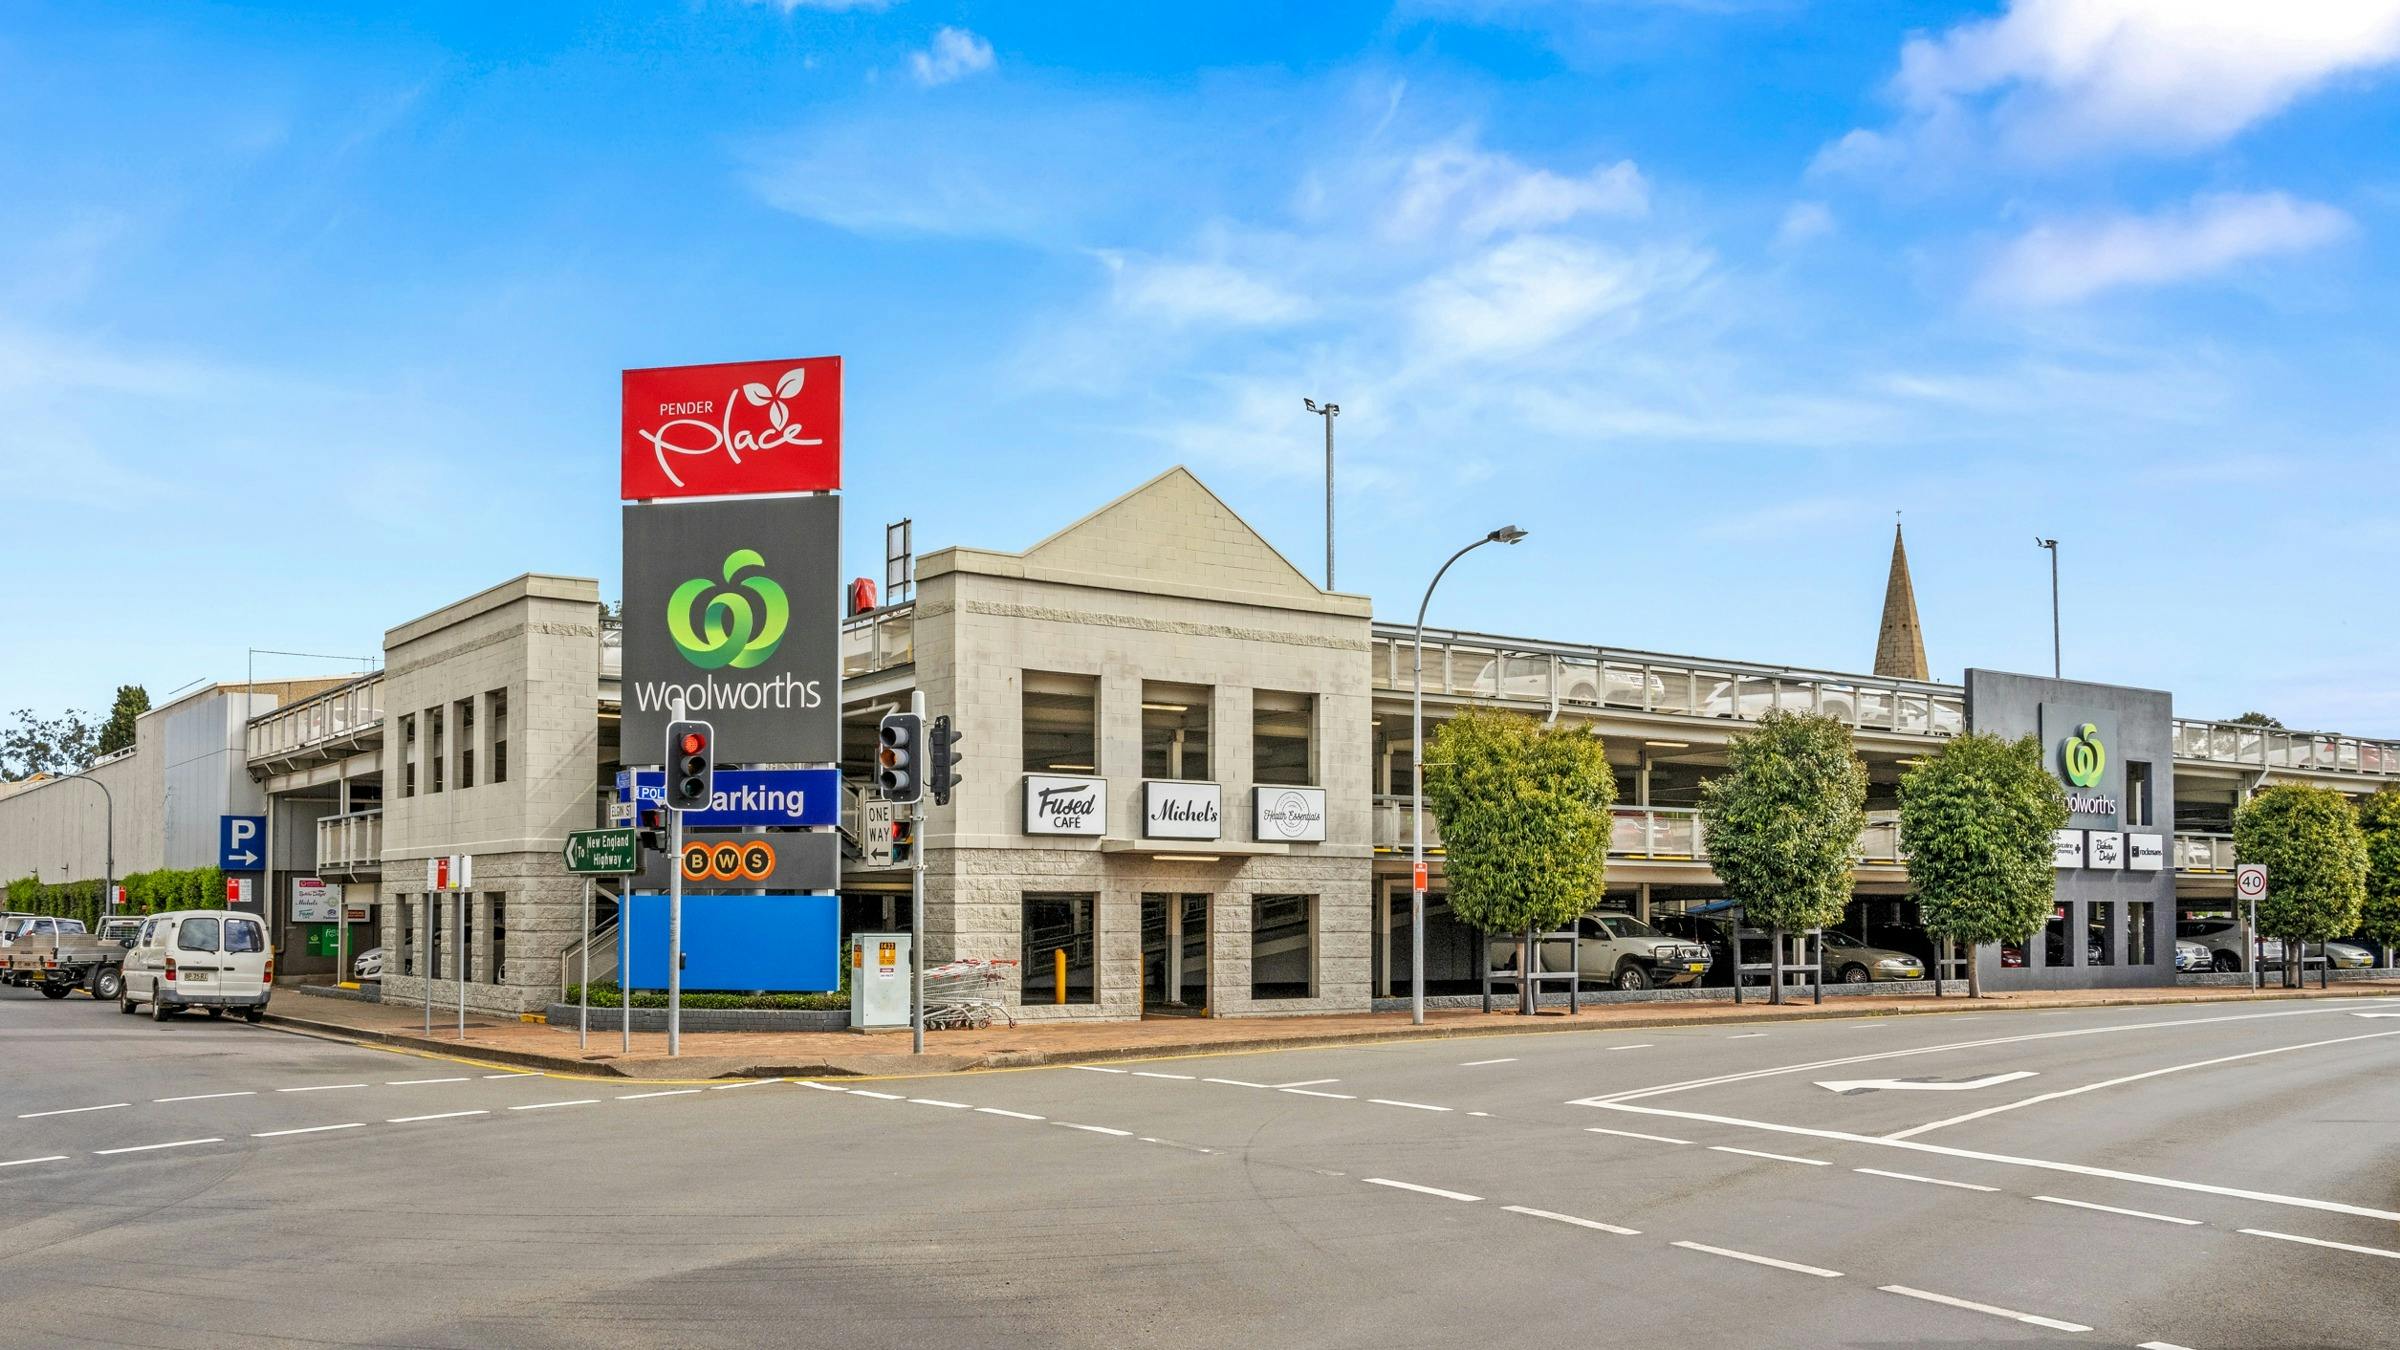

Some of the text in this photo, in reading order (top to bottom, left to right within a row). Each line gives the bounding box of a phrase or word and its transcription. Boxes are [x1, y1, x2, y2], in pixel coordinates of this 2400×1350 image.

[659, 401, 714, 417] PENDER
[635, 672, 822, 712] Woolworths
[641, 787, 665, 799] POL
[711, 784, 804, 817] arking
[1038, 784, 1096, 818] Fused
[1151, 799, 1218, 822] Michel's
[2052, 792, 2116, 815] olworths
[869, 806, 889, 822] ONE
[1053, 816, 1081, 828] CAFÉ
[231, 819, 256, 849] P
[869, 827, 890, 842] WAY
[587, 834, 628, 851] New England
[578, 845, 585, 858] To
[593, 851, 622, 869] Highway
[691, 853, 762, 869] BWS
[2242, 876, 2261, 888] 40
